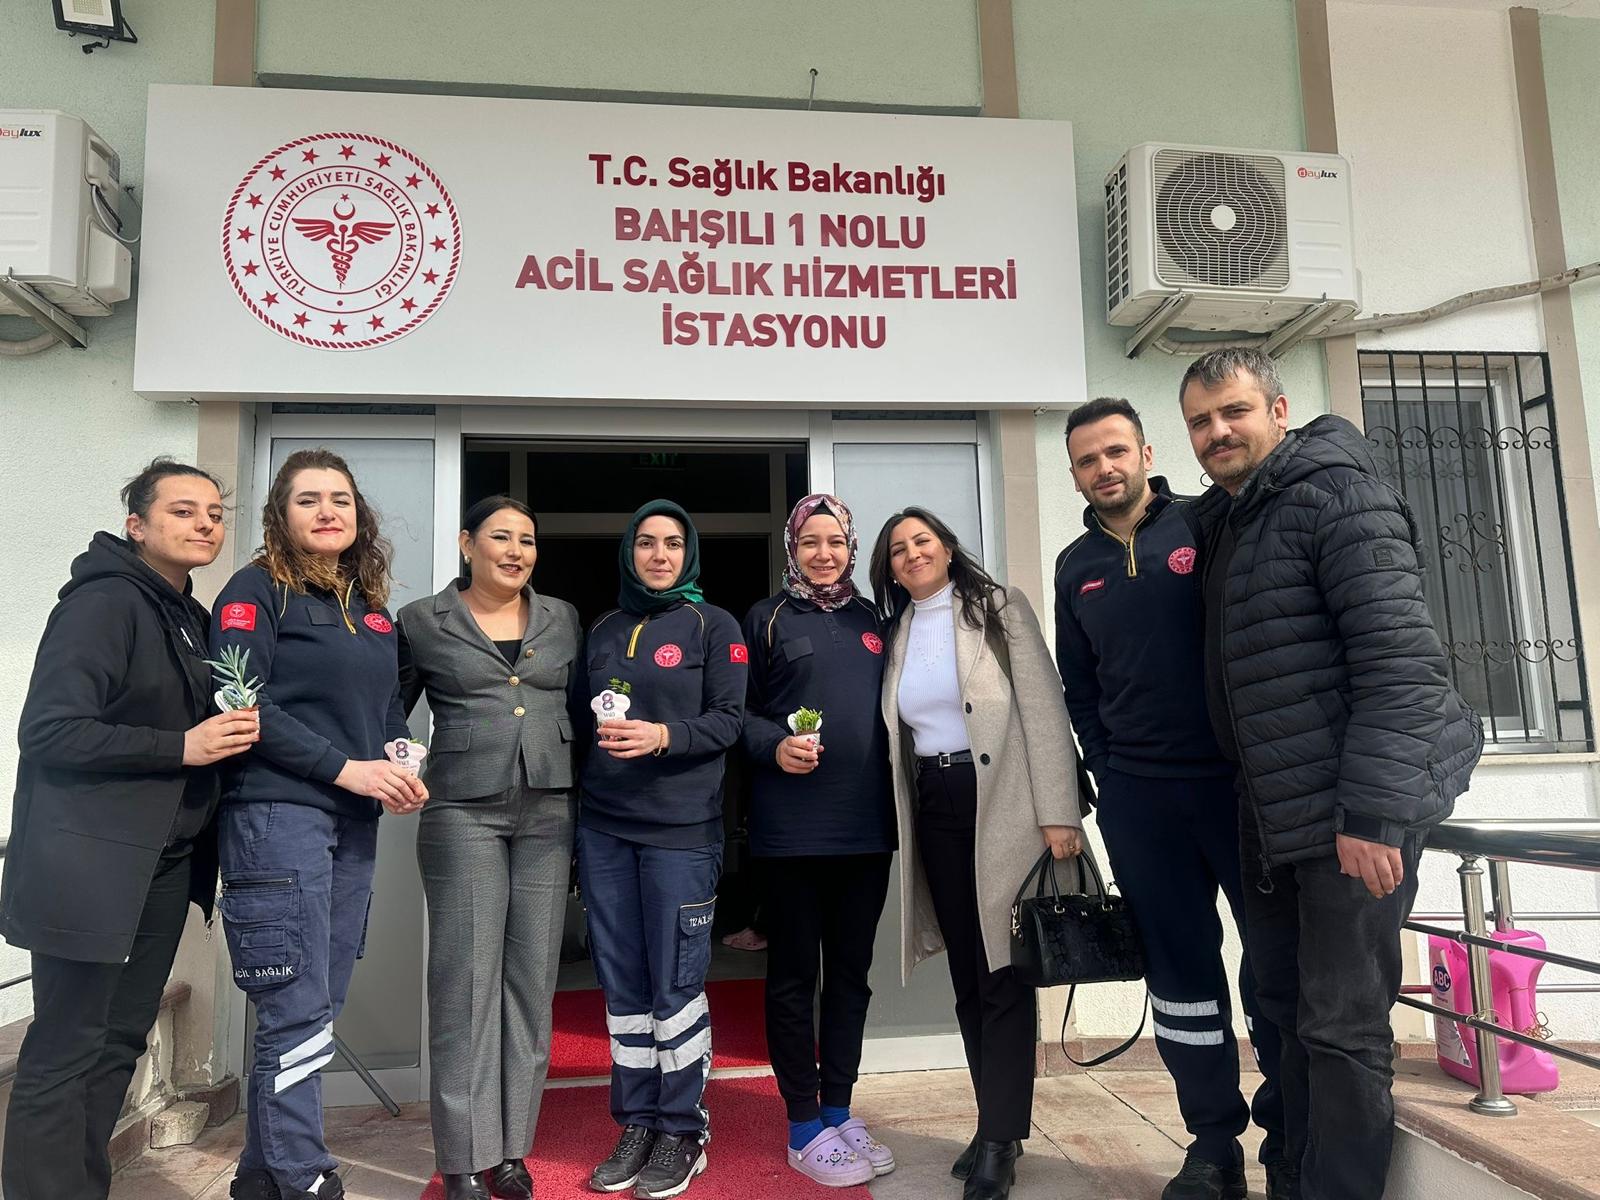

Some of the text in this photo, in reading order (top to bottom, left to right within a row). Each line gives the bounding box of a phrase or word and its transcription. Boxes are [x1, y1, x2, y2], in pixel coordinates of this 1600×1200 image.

[589, 154, 946, 203] T.C. Sağlık Bakanlığı
[267, 171, 417, 299] TÜRKİYE CUMHURİYETİ SAĞLIK BAKANLIĞI
[615, 207, 927, 249] BAHŞILI 1 NOLU
[515, 248, 1018, 300] ACİL SAĞLIK HİZMETLERİ
[661, 302, 887, 349] İSTASYONU
[639, 452, 678, 465] EXIT
[602, 693, 614, 711] 8
[396, 741, 409, 759] 8
[255, 966, 293, 977] SAĞLIK
[1434, 969, 1451, 989] ABC
